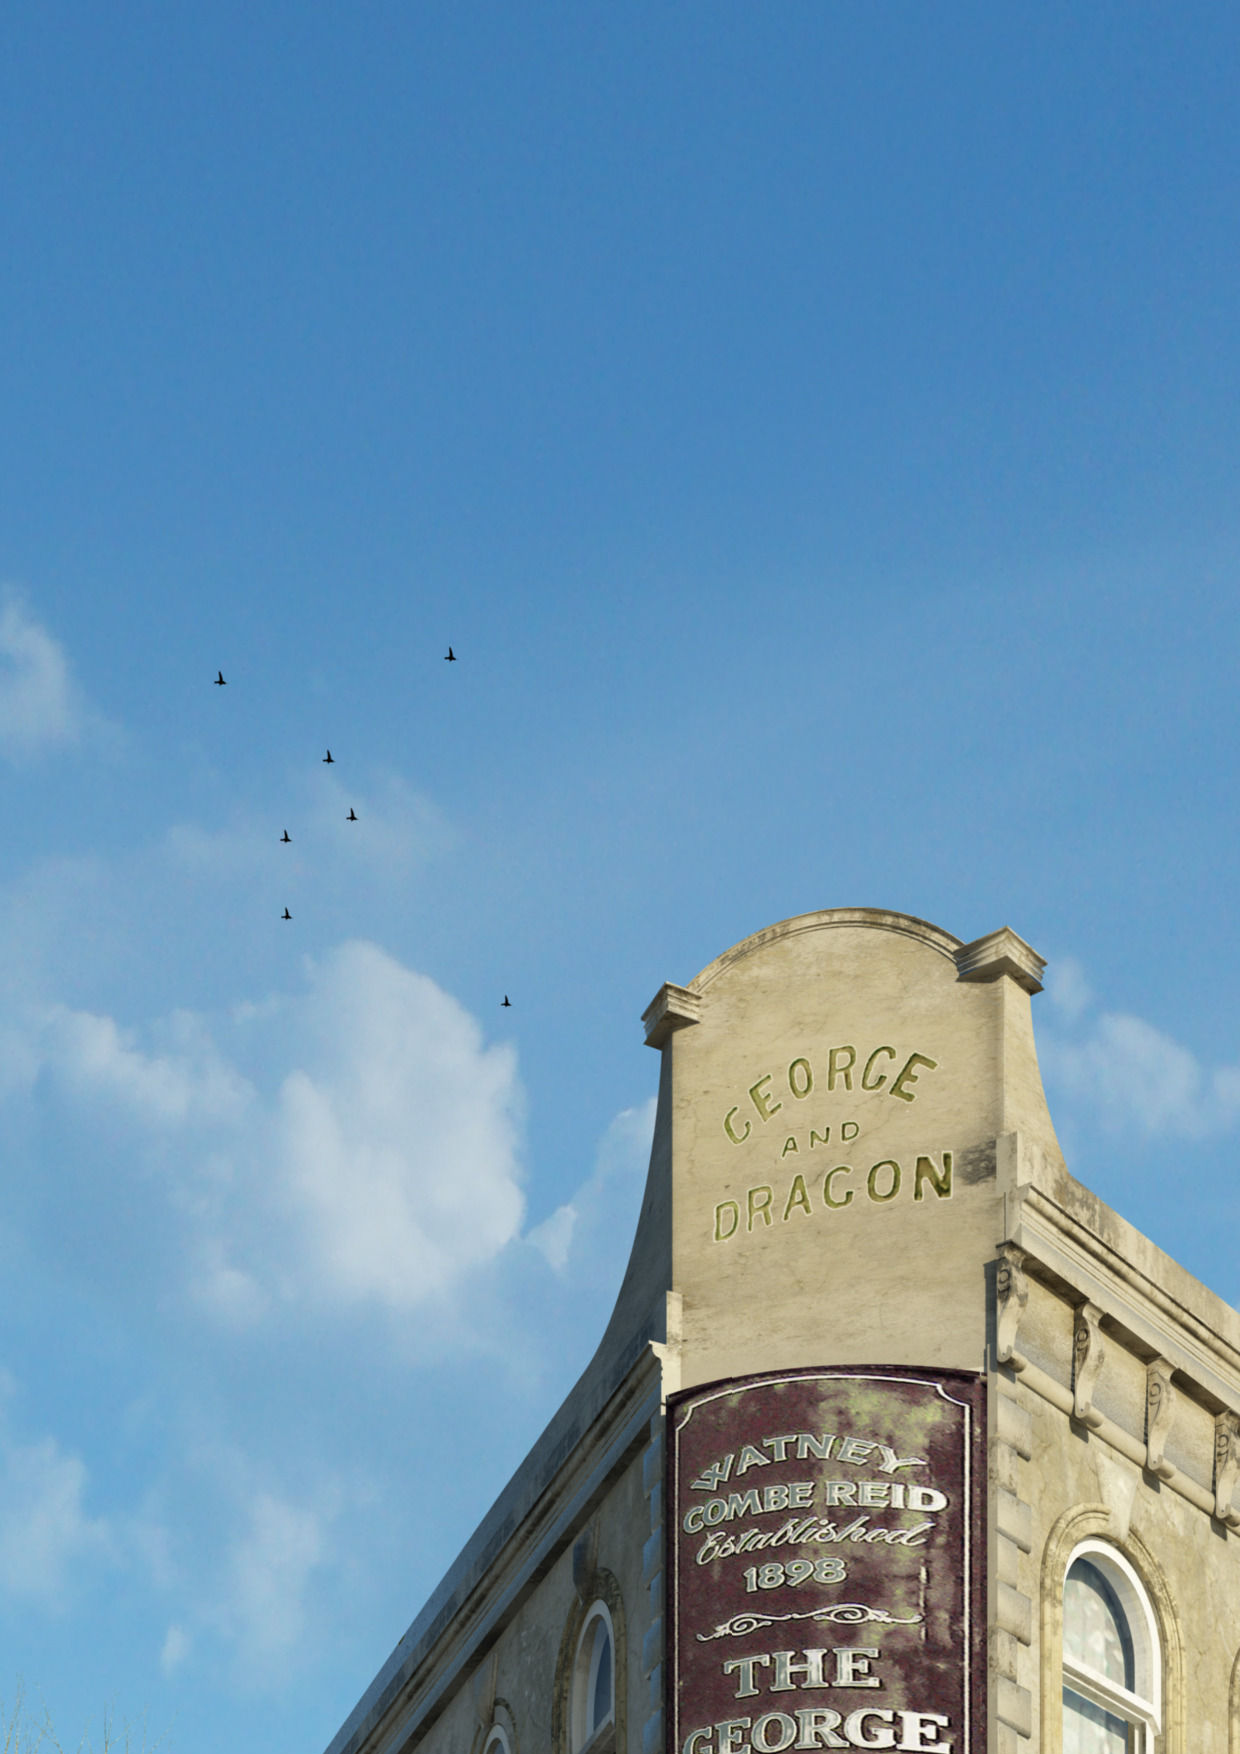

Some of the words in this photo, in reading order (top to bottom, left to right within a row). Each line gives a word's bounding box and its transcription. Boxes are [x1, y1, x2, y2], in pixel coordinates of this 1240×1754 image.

[723, 1045, 938, 1145] GEORGE
[782, 1121, 860, 1159] AND
[714, 1151, 953, 1242] DRAGON
[691, 1434, 927, 1491] WATNEY
[683, 1481, 814, 1534] COMBE
[825, 1481, 948, 1512] REID
[696, 1516, 936, 1565] Established
[743, 1558, 846, 1592] 1898
[723, 1648, 880, 1698] THE
